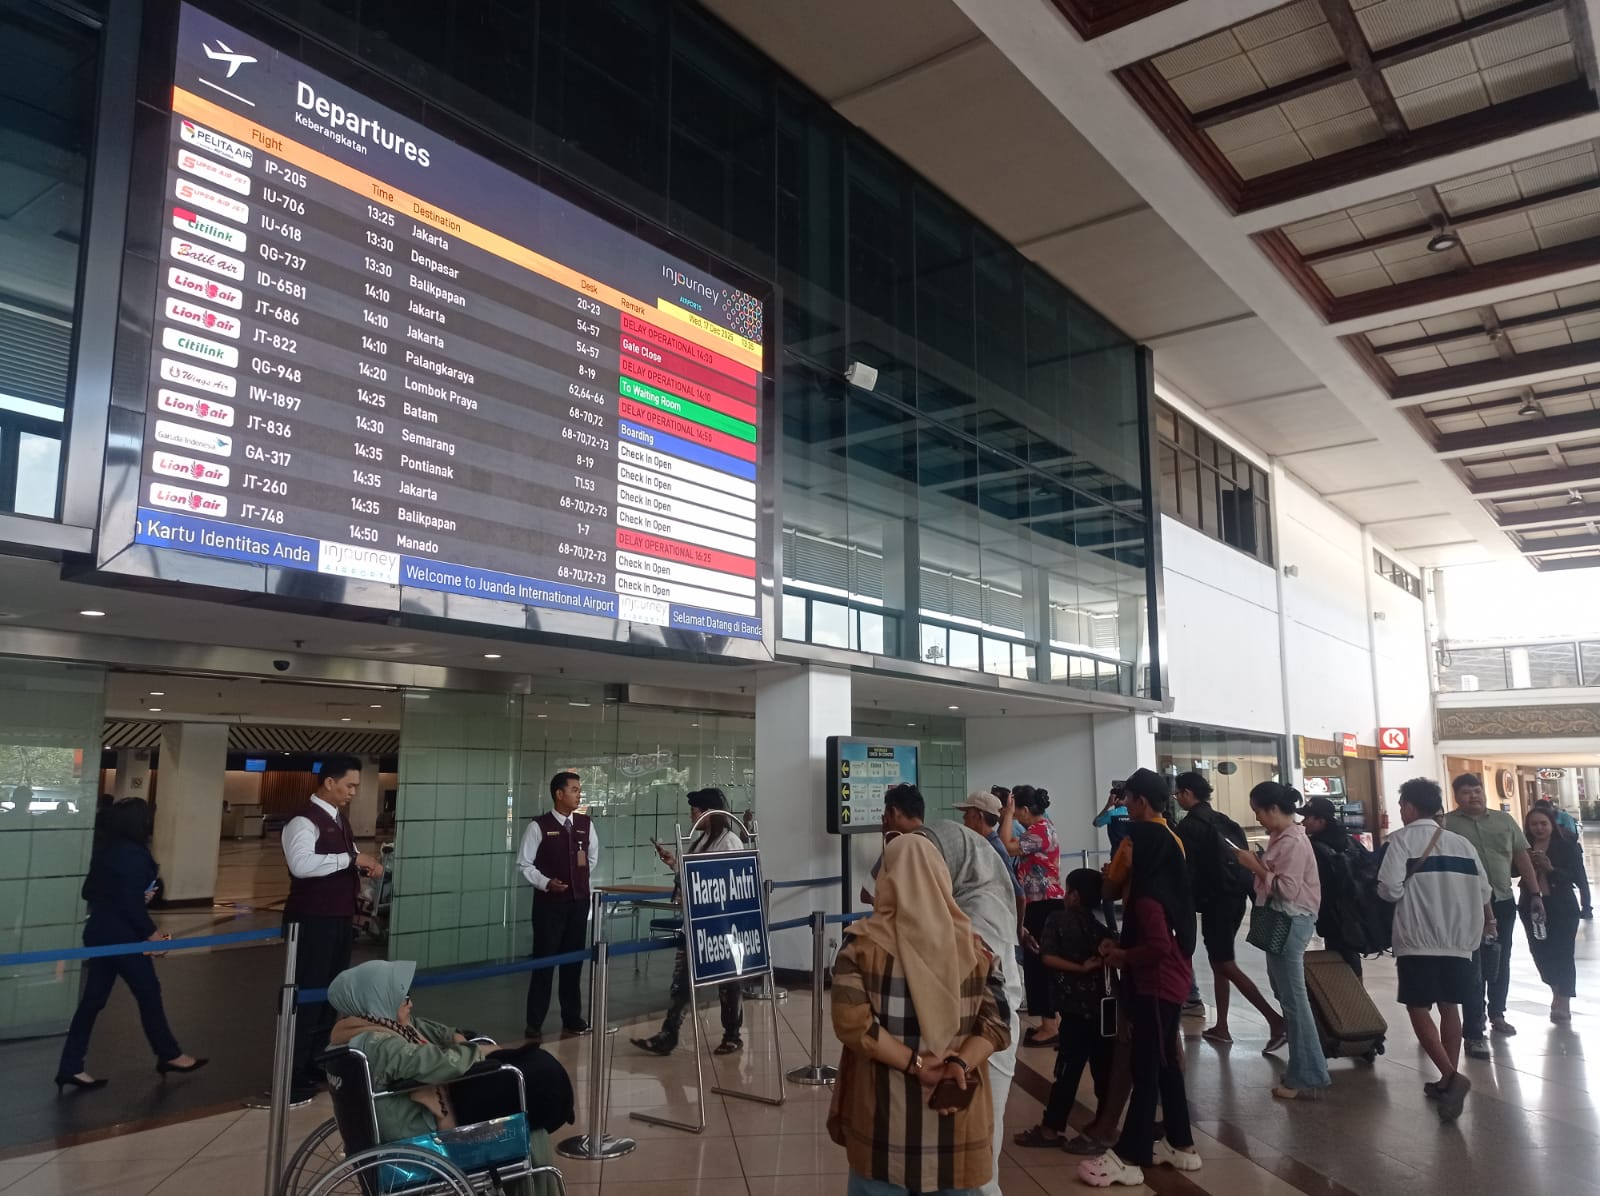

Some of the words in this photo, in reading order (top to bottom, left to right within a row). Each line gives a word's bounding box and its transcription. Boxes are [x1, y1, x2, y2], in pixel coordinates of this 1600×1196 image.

[295, 112, 367, 155] Keberangkatan
[297, 80, 430, 167] Departures
[197, 131, 233, 154] PELITA
[235, 148, 252, 162] AIR
[252, 128, 283, 152] Flight
[182, 156, 217, 173] SUPER
[265, 159, 307, 189] IP-205
[180, 185, 215, 201] SUPER
[263, 187, 305, 215] IU-706
[372, 184, 394, 202] Time
[367, 205, 395, 227] 13:25
[413, 203, 461, 232] Destination
[261, 215, 302, 241] IU-618
[412, 225, 449, 251] Jakarta
[366, 231, 394, 252] 13:30
[178, 243, 215, 266] Batik
[217, 258, 238, 274] air
[259, 244, 306, 271] QG-737
[364, 257, 392, 278] 13:30
[411, 249, 460, 279] Denpasar
[174, 275, 203, 292] Lion
[218, 291, 236, 303] air
[257, 271, 306, 300] ID-6581
[364, 283, 390, 303] 14:10
[409, 274, 466, 307] Balikpapan
[581, 280, 598, 294] Desk
[255, 300, 299, 325] JT-686
[408, 300, 446, 324] Jakarta
[577, 297, 601, 316] 20-23
[621, 298, 645, 315] Remark
[172, 305, 201, 322] Lion
[216, 320, 234, 332] air
[363, 309, 389, 329] 14:10
[576, 319, 600, 337] 54-57
[177, 337, 225, 359] Citilink
[253, 328, 297, 354] JT-822
[361, 336, 387, 355] 14:10
[406, 325, 444, 349] Jakarta
[623, 317, 647, 336] DELAY
[648, 327, 698, 357] OPERATIONAL
[576, 341, 600, 359] 54-57
[622, 339, 640, 354] Gate
[641, 346, 662, 363] Close
[251, 357, 302, 383] QG-948
[358, 362, 387, 381] 14:20
[405, 350, 474, 384] Palangkaraya
[578, 364, 596, 380] 8-19
[622, 360, 646, 377] DELAY
[647, 370, 698, 397] OPERATIONAL
[696, 390, 711, 402] 14:10
[249, 385, 302, 411] IW-1897
[357, 389, 386, 408] 14:25
[404, 376, 447, 400] Lombok
[449, 391, 478, 410] Praya
[568, 383, 605, 405] 62,64-66
[622, 381, 631, 393] To
[633, 386, 659, 405] Waiting
[660, 395, 681, 412] Room
[164, 396, 193, 412] Lion
[209, 409, 228, 420] air
[403, 402, 438, 423] Batam
[569, 406, 603, 427] 68-70,72
[247, 415, 292, 438] JT-836
[355, 415, 384, 435] 14:30
[621, 402, 645, 419] DELAY
[646, 411, 695, 437] OPERATIONAL
[696, 428, 712, 442] 14:50
[158, 430, 184, 444] Garuda
[184, 437, 217, 450] Indonesia
[401, 428, 455, 456] Semarang
[561, 427, 609, 451] 68-70,72-73
[621, 423, 654, 446] Boarding
[245, 444, 291, 467] GA-317
[354, 442, 383, 461] 14:35
[576, 454, 594, 469] 8-19
[621, 446, 644, 460] Check
[645, 453, 652, 463] In
[654, 456, 672, 470] Open
[159, 458, 189, 474] Lion
[205, 469, 224, 480] air
[352, 469, 381, 488] 14:35
[400, 455, 454, 479] Pontianak
[242, 474, 288, 495] JT-260
[399, 480, 438, 501] Jakarta
[574, 475, 595, 491] T1.53
[620, 468, 644, 481] Check
[645, 475, 652, 485] In
[654, 478, 672, 491] Open
[157, 489, 186, 505] Lion
[202, 499, 221, 510] air
[351, 497, 380, 515] 14:35
[560, 495, 608, 517] 68-70,72-73
[620, 489, 643, 503] Check
[645, 497, 652, 506] In
[653, 499, 672, 512] Open
[240, 503, 284, 525] JT-748
[398, 507, 456, 531] Balikpapan
[619, 511, 643, 525] Check
[645, 518, 652, 527] In
[653, 520, 671, 533] Open
[147, 519, 195, 543] Kartu
[201, 529, 270, 555] Identitas
[273, 541, 311, 562] Anda
[349, 525, 378, 542] 14:50
[577, 522, 590, 536] 1-7
[396, 534, 439, 553] Manado
[558, 542, 607, 562] 68-70,72-73
[619, 533, 643, 548] DELAY
[644, 539, 694, 559] OPERATIONAL
[695, 551, 711, 563] 16:25
[557, 566, 606, 585] 68-70,72-73
[618, 555, 642, 569] Check
[644, 562, 651, 571] In
[652, 564, 671, 576] Open
[406, 564, 462, 587] Welcome
[465, 575, 476, 589] to
[478, 579, 516, 596] Juanda
[518, 584, 581, 607] International
[583, 595, 614, 613] Airport
[618, 578, 642, 591] Check
[643, 583, 651, 592] In
[652, 586, 671, 597] Open
[673, 610, 705, 627] Selamat
[706, 616, 732, 632] Datang
[733, 620, 740, 632] di
[691, 871, 726, 911] Harap
[729, 866, 755, 900] Antri
[696, 928, 730, 964] Please
[731, 923, 761, 956] Queue
